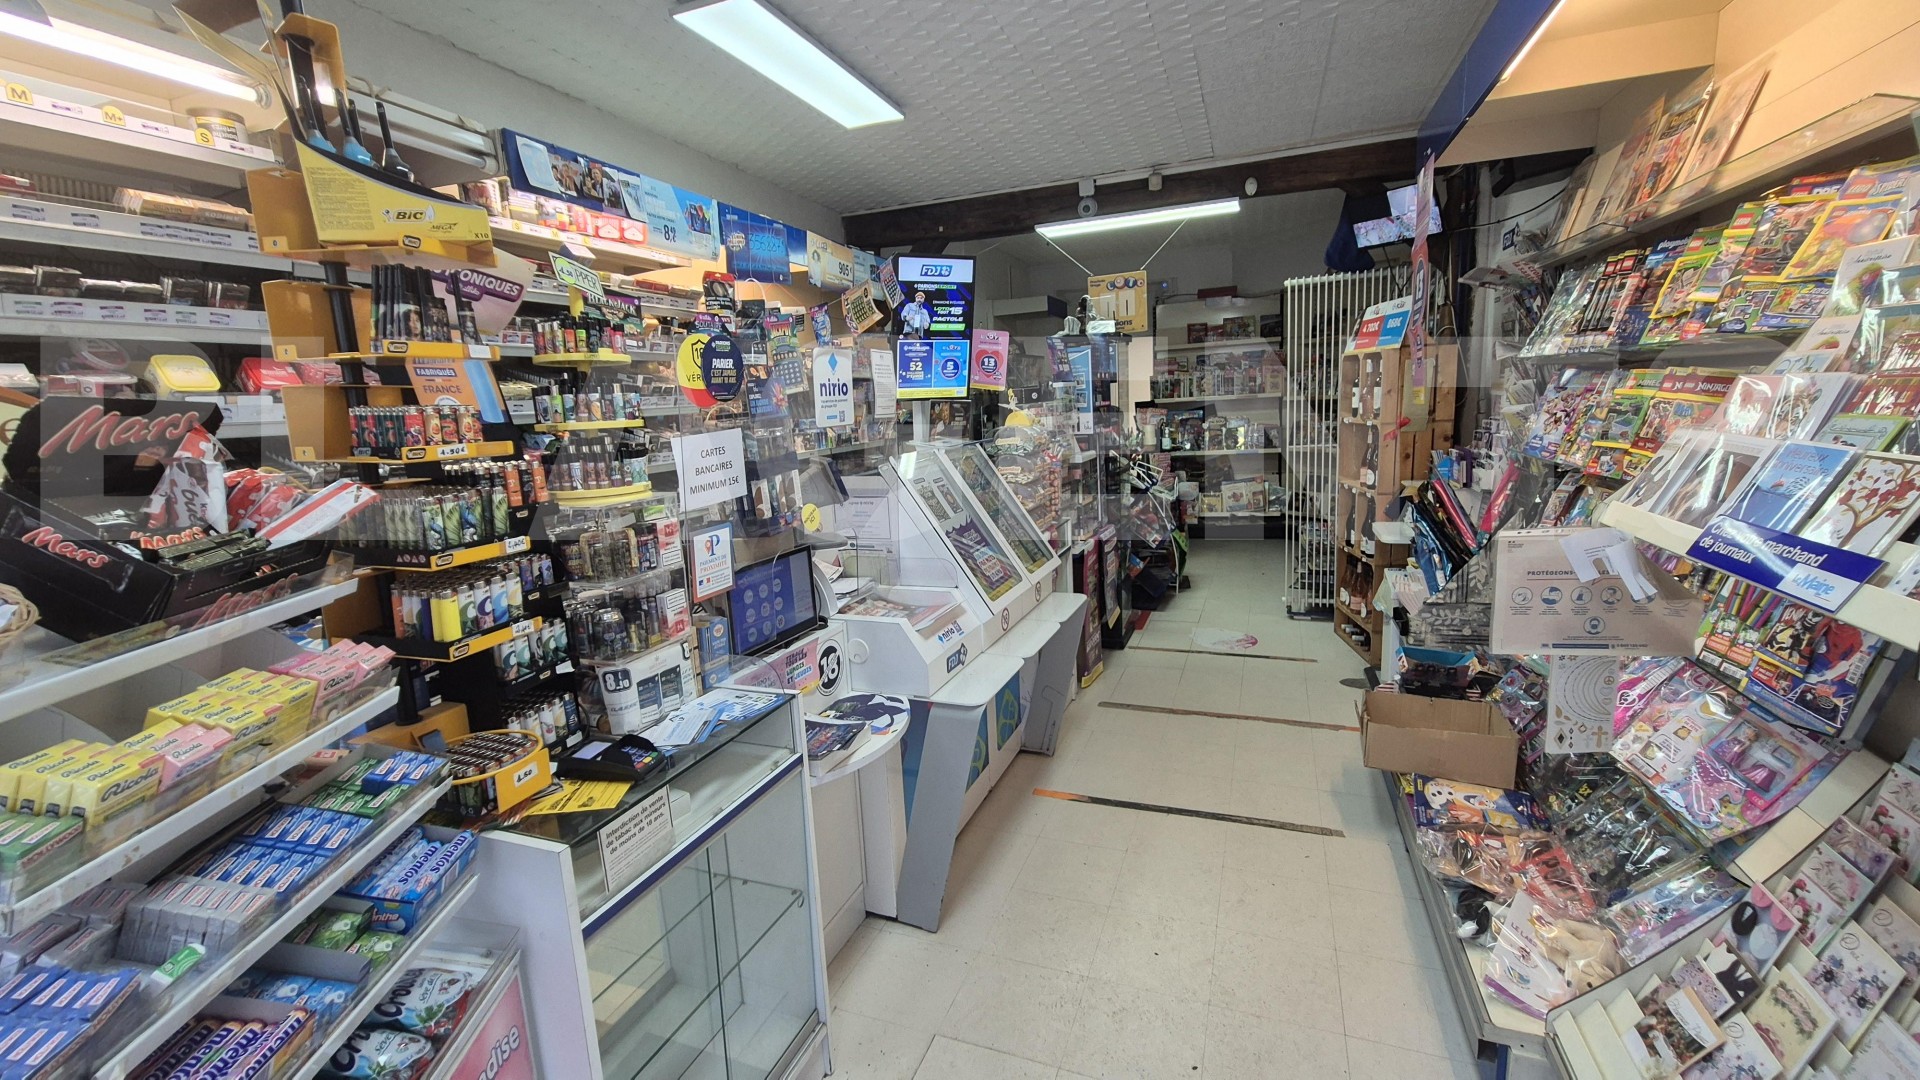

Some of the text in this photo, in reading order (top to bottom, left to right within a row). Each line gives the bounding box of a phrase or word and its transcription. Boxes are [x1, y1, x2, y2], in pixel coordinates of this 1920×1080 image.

[11, 88, 28, 101] M
[105, 110, 124, 123] M+
[200, 131, 210, 143] S
[396, 211, 424, 221] BIC
[1735, 217, 1752, 226] LEGO
[922, 266, 940, 275] FDJ
[712, 358, 735, 369] PARIER,
[910, 362, 922, 371] 52
[947, 362, 954, 370] 5
[983, 358, 995, 366] 13
[424, 385, 462, 394] FRANCE
[819, 378, 848, 397] nirio
[38, 405, 200, 458] Mars
[701, 446, 726, 459] CARTES
[695, 461, 733, 477] BANCAIRES
[690, 475, 740, 496] MINIMUM 15€
[22, 526, 109, 568] Mars
[1700, 536, 1756, 565] de journaux
[1762, 540, 1828, 567] marchand
[1800, 574, 1836, 596] Maine
[942, 627, 955, 640] nirio
[786, 662, 805, 676] LUNDIS
[794, 665, 813, 679] JEUDIS
[159, 698, 189, 711] Ricola
[182, 702, 211, 715] Ricola
[204, 705, 233, 719] Ricola
[226, 709, 254, 723] Ricola
[234, 716, 278, 741] Ricola
[124, 732, 155, 750] Ricola
[172, 741, 203, 759] Ricola
[9, 752, 50, 769] Ricola
[36, 755, 76, 774] Ricola
[61, 760, 101, 778] Ricola
[87, 763, 126, 782] Ricola
[101, 767, 159, 803] Ricola
[606, 795, 664, 840] Interdiction de vente
[606, 802, 666, 849] de tabac aux mineurs
[609, 845, 618, 855] de
[618, 832, 637, 847] moins
[637, 825, 645, 834] de
[430, 835, 468, 873] mentos
[398, 845, 438, 885] mentos
